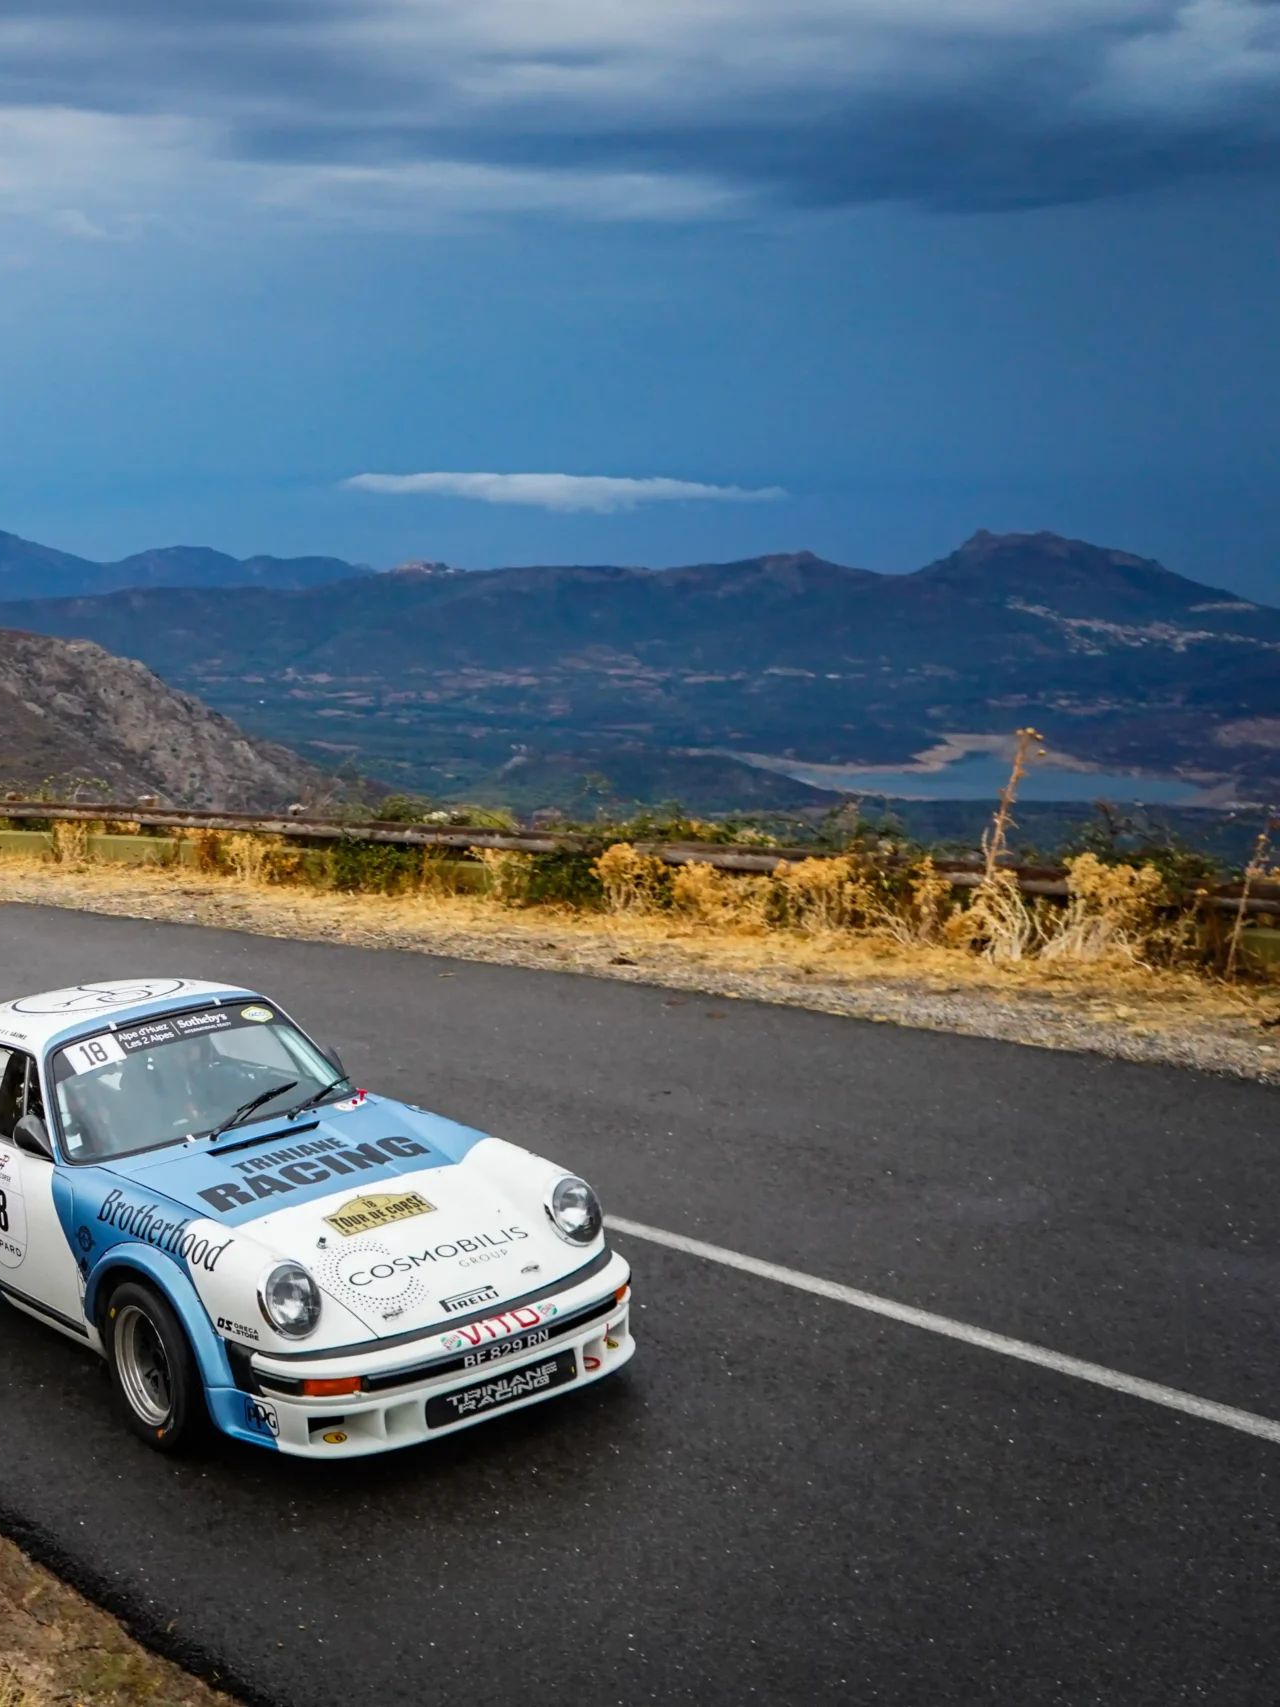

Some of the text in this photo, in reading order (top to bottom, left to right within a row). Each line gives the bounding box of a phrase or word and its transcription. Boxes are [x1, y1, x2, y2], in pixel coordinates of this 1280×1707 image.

[118, 1023, 170, 1043] Alpe d'Huez
[177, 1013, 228, 1029] Sotheby's
[79, 1041, 109, 1067] 18
[125, 1030, 175, 1050] Les 2 Alpes
[231, 1136, 352, 1175] TRINIANE
[196, 1135, 432, 1213] RACING
[328, 1194, 428, 1230] TOUR DE CORSE
[361, 1200, 378, 1210] 18
[97, 1188, 236, 1272] Brotherhood
[348, 1226, 530, 1286] COSMOBILIS
[458, 1248, 509, 1268] GROUP
[438, 1285, 500, 1313] PIRELLI
[234, 1322, 259, 1336] ORECA
[464, 1329, 550, 1369] BF 829 RN
[446, 1360, 558, 1406] TRINIANE
[457, 1374, 551, 1414] RACING
